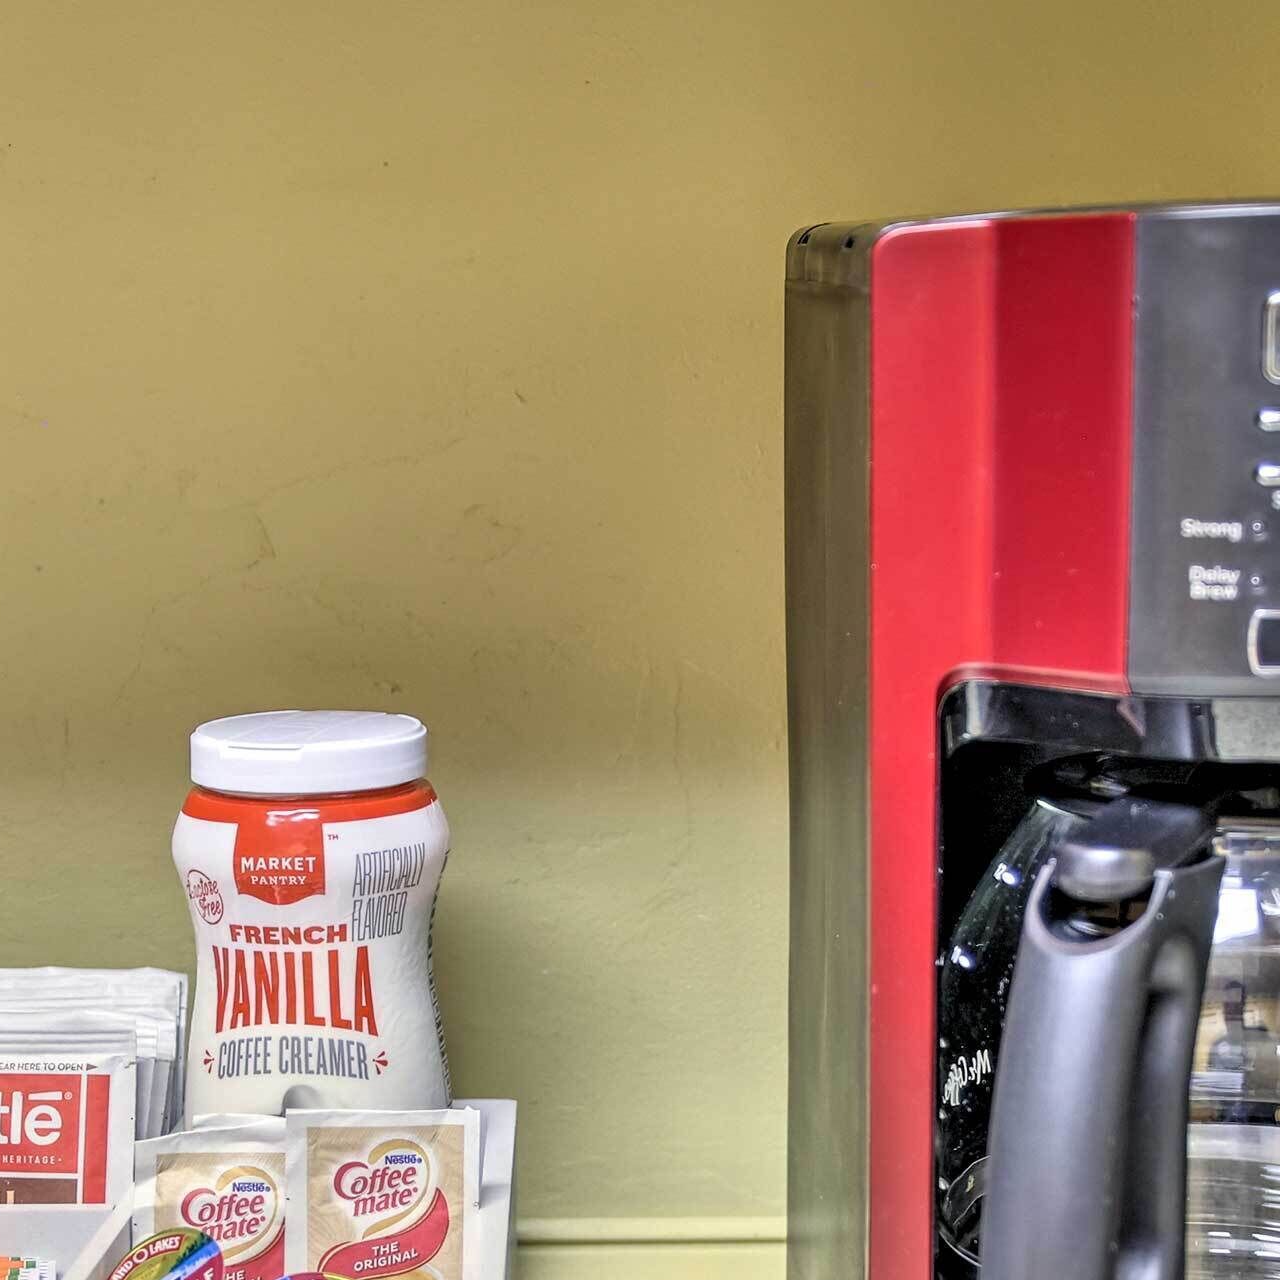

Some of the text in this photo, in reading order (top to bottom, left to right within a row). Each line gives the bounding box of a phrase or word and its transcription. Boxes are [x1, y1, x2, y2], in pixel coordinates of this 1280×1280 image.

[1180, 518, 1242, 543] Strong
[1188, 565, 1240, 584] Delay
[1189, 582, 1238, 600] Brew
[241, 857, 316, 874] MARKET
[352, 843, 425, 898] ARTIFICIALLY
[250, 875, 307, 887] PANTRY
[199, 897, 222, 917] Free
[351, 891, 407, 942] FLAVORED
[229, 924, 347, 945] FRENCH
[213, 946, 379, 1037] VANILLA
[17, 1062, 40, 1071] HERE
[42, 1062, 56, 1071] TO
[57, 1062, 83, 1071] OPEN
[218, 1037, 370, 1080] COFFEE CREAMER
[3, 1153, 56, 1165] HERITAGE
[334, 1161, 417, 1200] Coffee
[181, 1188, 264, 1226] Coffee
[353, 1191, 411, 1217] mate
[202, 1217, 260, 1243] mate
[133, 1249, 148, 1264] O
[150, 1236, 181, 1253] LAKES
[372, 1242, 399, 1254] THE
[354, 1250, 418, 1272] ORIGINAL
